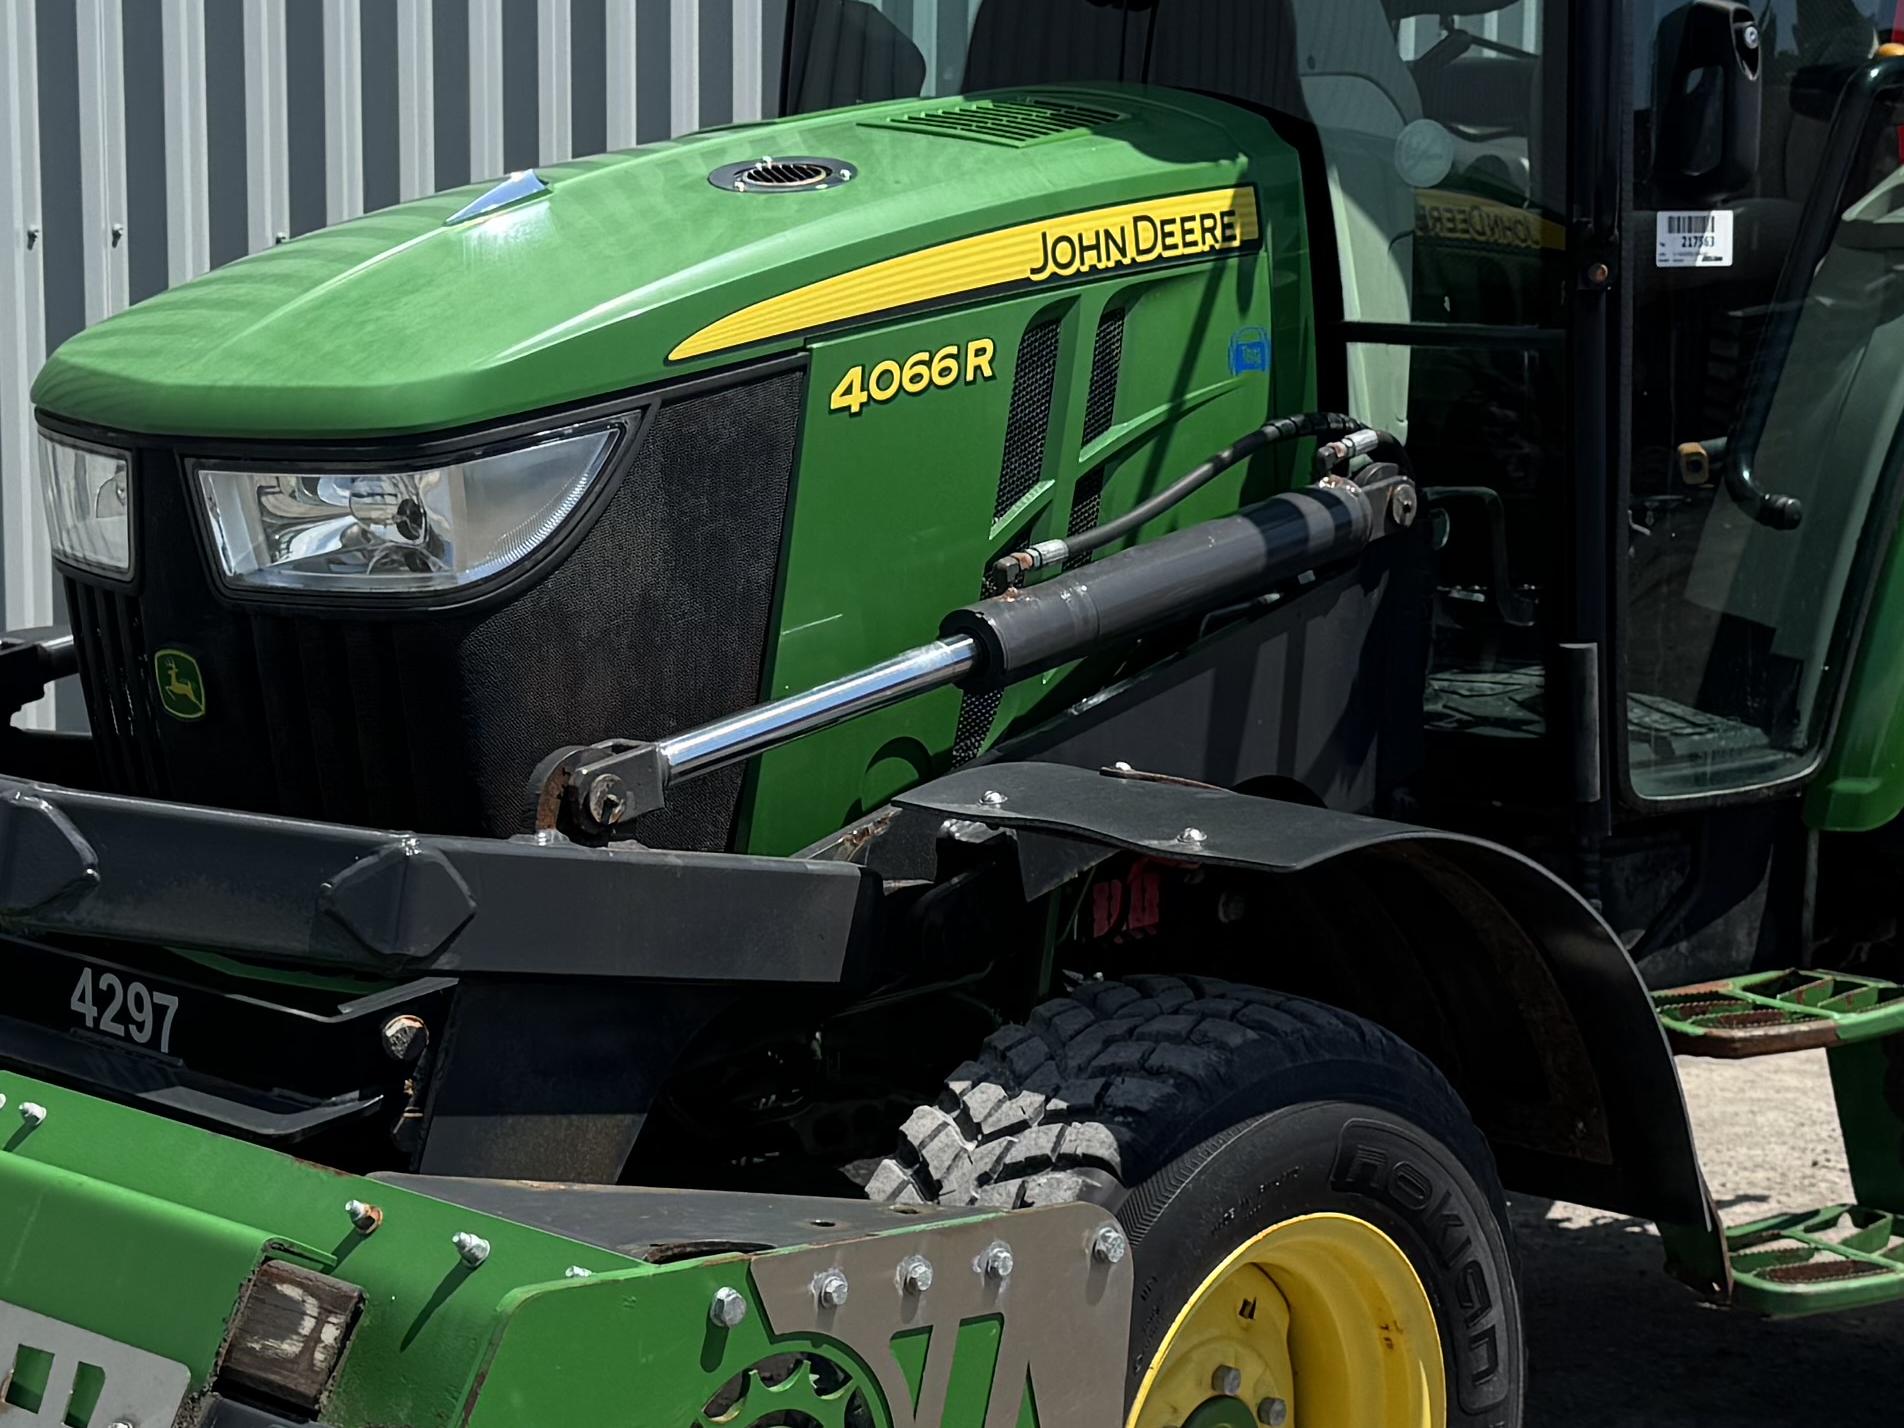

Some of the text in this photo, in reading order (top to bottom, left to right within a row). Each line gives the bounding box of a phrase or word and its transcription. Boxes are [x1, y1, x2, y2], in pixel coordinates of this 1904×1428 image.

[1030, 209, 1238, 276] JOHN DEERE
[71, 967, 179, 1053] 4297
